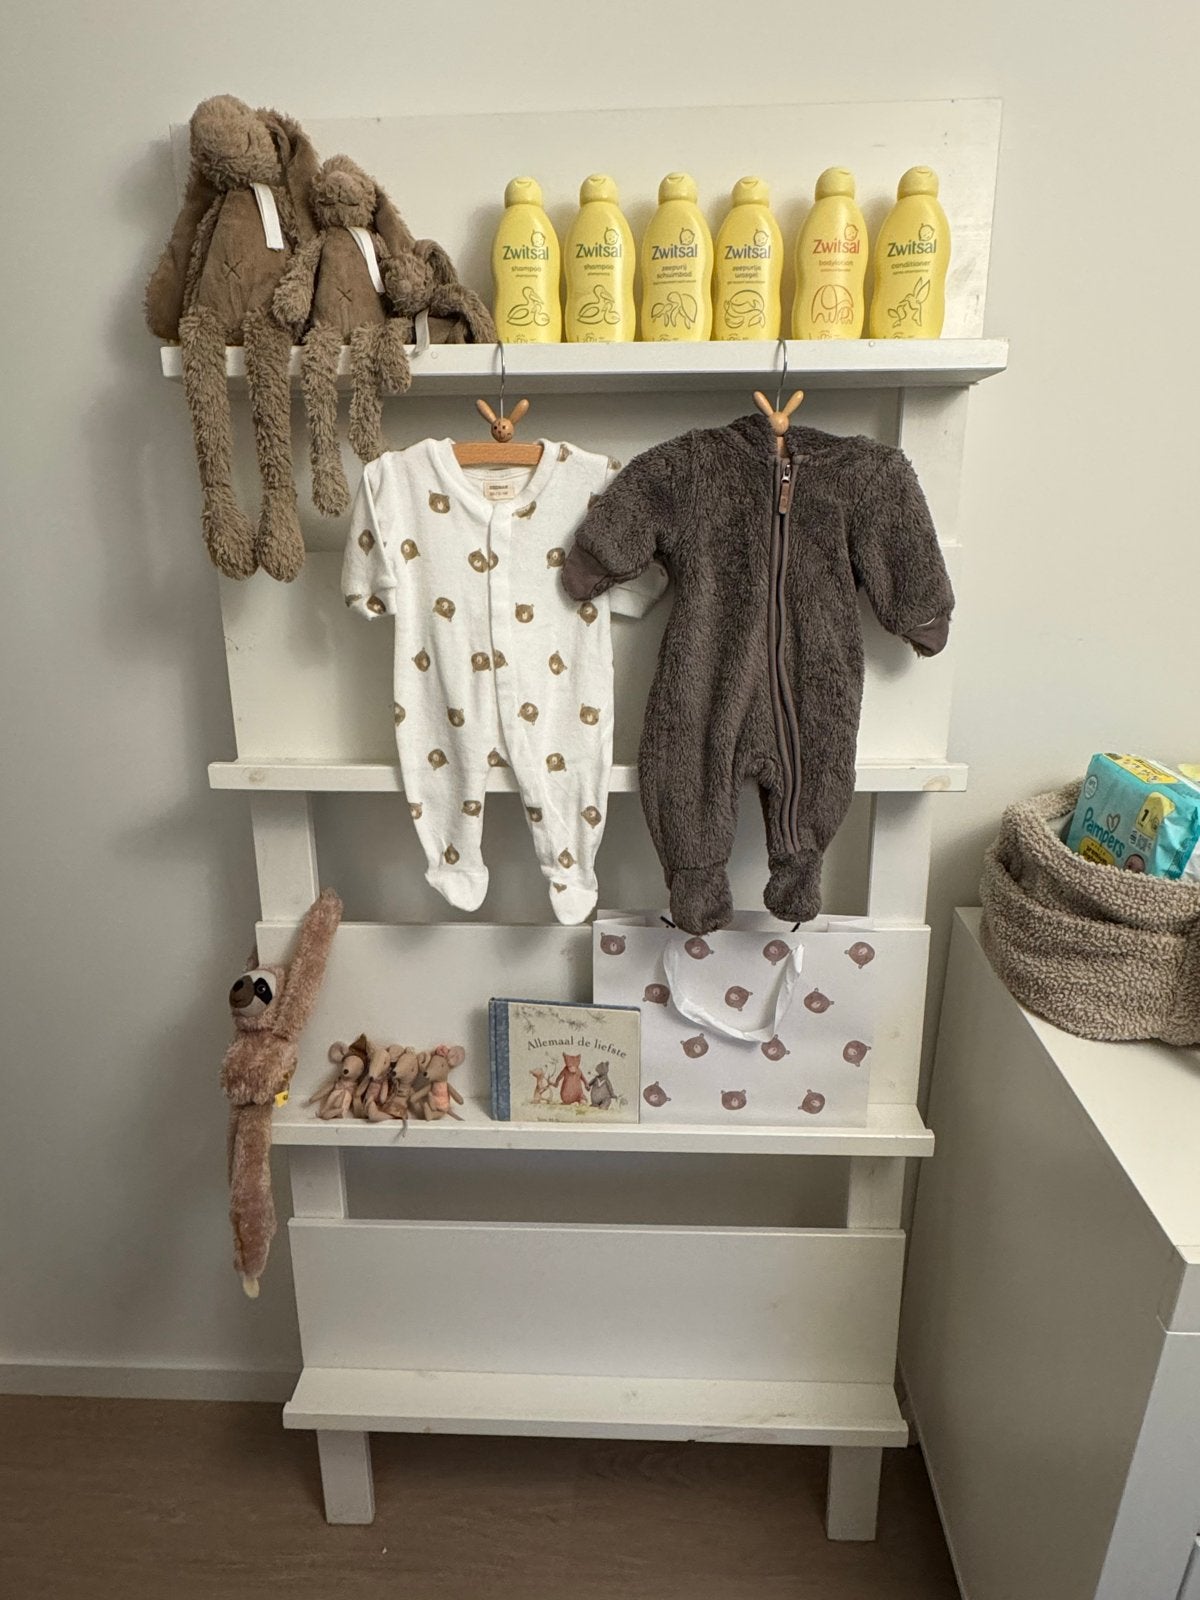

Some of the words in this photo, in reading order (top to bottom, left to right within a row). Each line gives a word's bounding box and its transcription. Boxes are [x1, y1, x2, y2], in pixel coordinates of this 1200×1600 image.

[503, 245, 549, 260] Zwitsal
[575, 242, 622, 259] Zwitsal
[652, 244, 698, 260] Zwitsal
[725, 244, 771, 260] Zwitsal
[812, 238, 860, 254] Zwitsal
[887, 239, 937, 257] Zwitsal
[511, 265, 542, 273] shampoo
[583, 263, 615, 271] shampoo
[818, 259, 854, 267] bodylotion
[891, 260, 931, 269] conditioner
[1141, 808, 1149, 821] 1
[1081, 806, 1126, 858] Pampers
[527, 1036, 574, 1051] Allemaal
[577, 1036, 591, 1048] de
[594, 1038, 627, 1058] liefste
